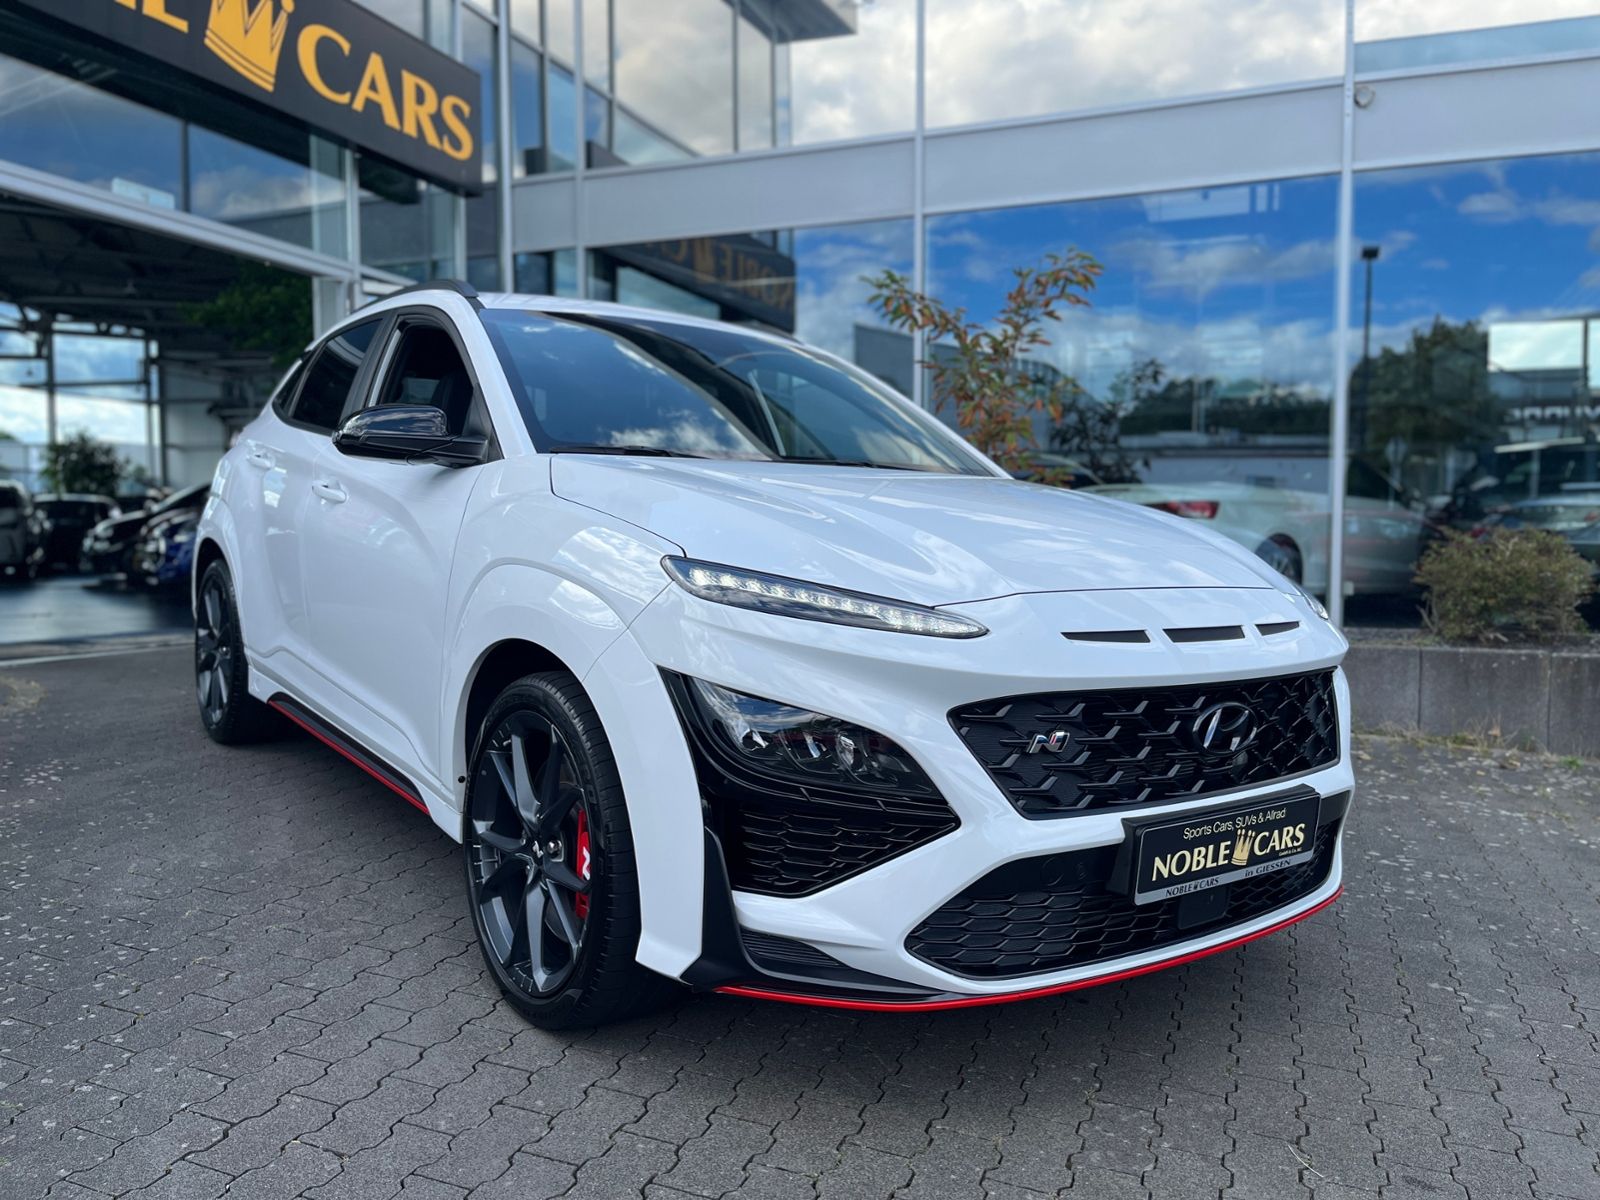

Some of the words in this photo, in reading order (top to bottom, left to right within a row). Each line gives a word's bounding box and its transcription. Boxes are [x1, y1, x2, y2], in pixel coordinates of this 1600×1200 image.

[297, 24, 474, 161] CARS
[1183, 824, 1212, 840] Sports
[1213, 820, 1234, 834] Cars,
[1235, 813, 1257, 829] SUVs
[1257, 812, 1264, 824] &
[1265, 807, 1287, 821] Allrad
[1151, 841, 1231, 881] NOBLE
[1253, 823, 1305, 856] CARS
[1165, 885, 1193, 898] NOBLE
[1200, 877, 1220, 891] CARS
[1244, 868, 1254, 878] in
[1255, 859, 1291, 876] GIESSEN
